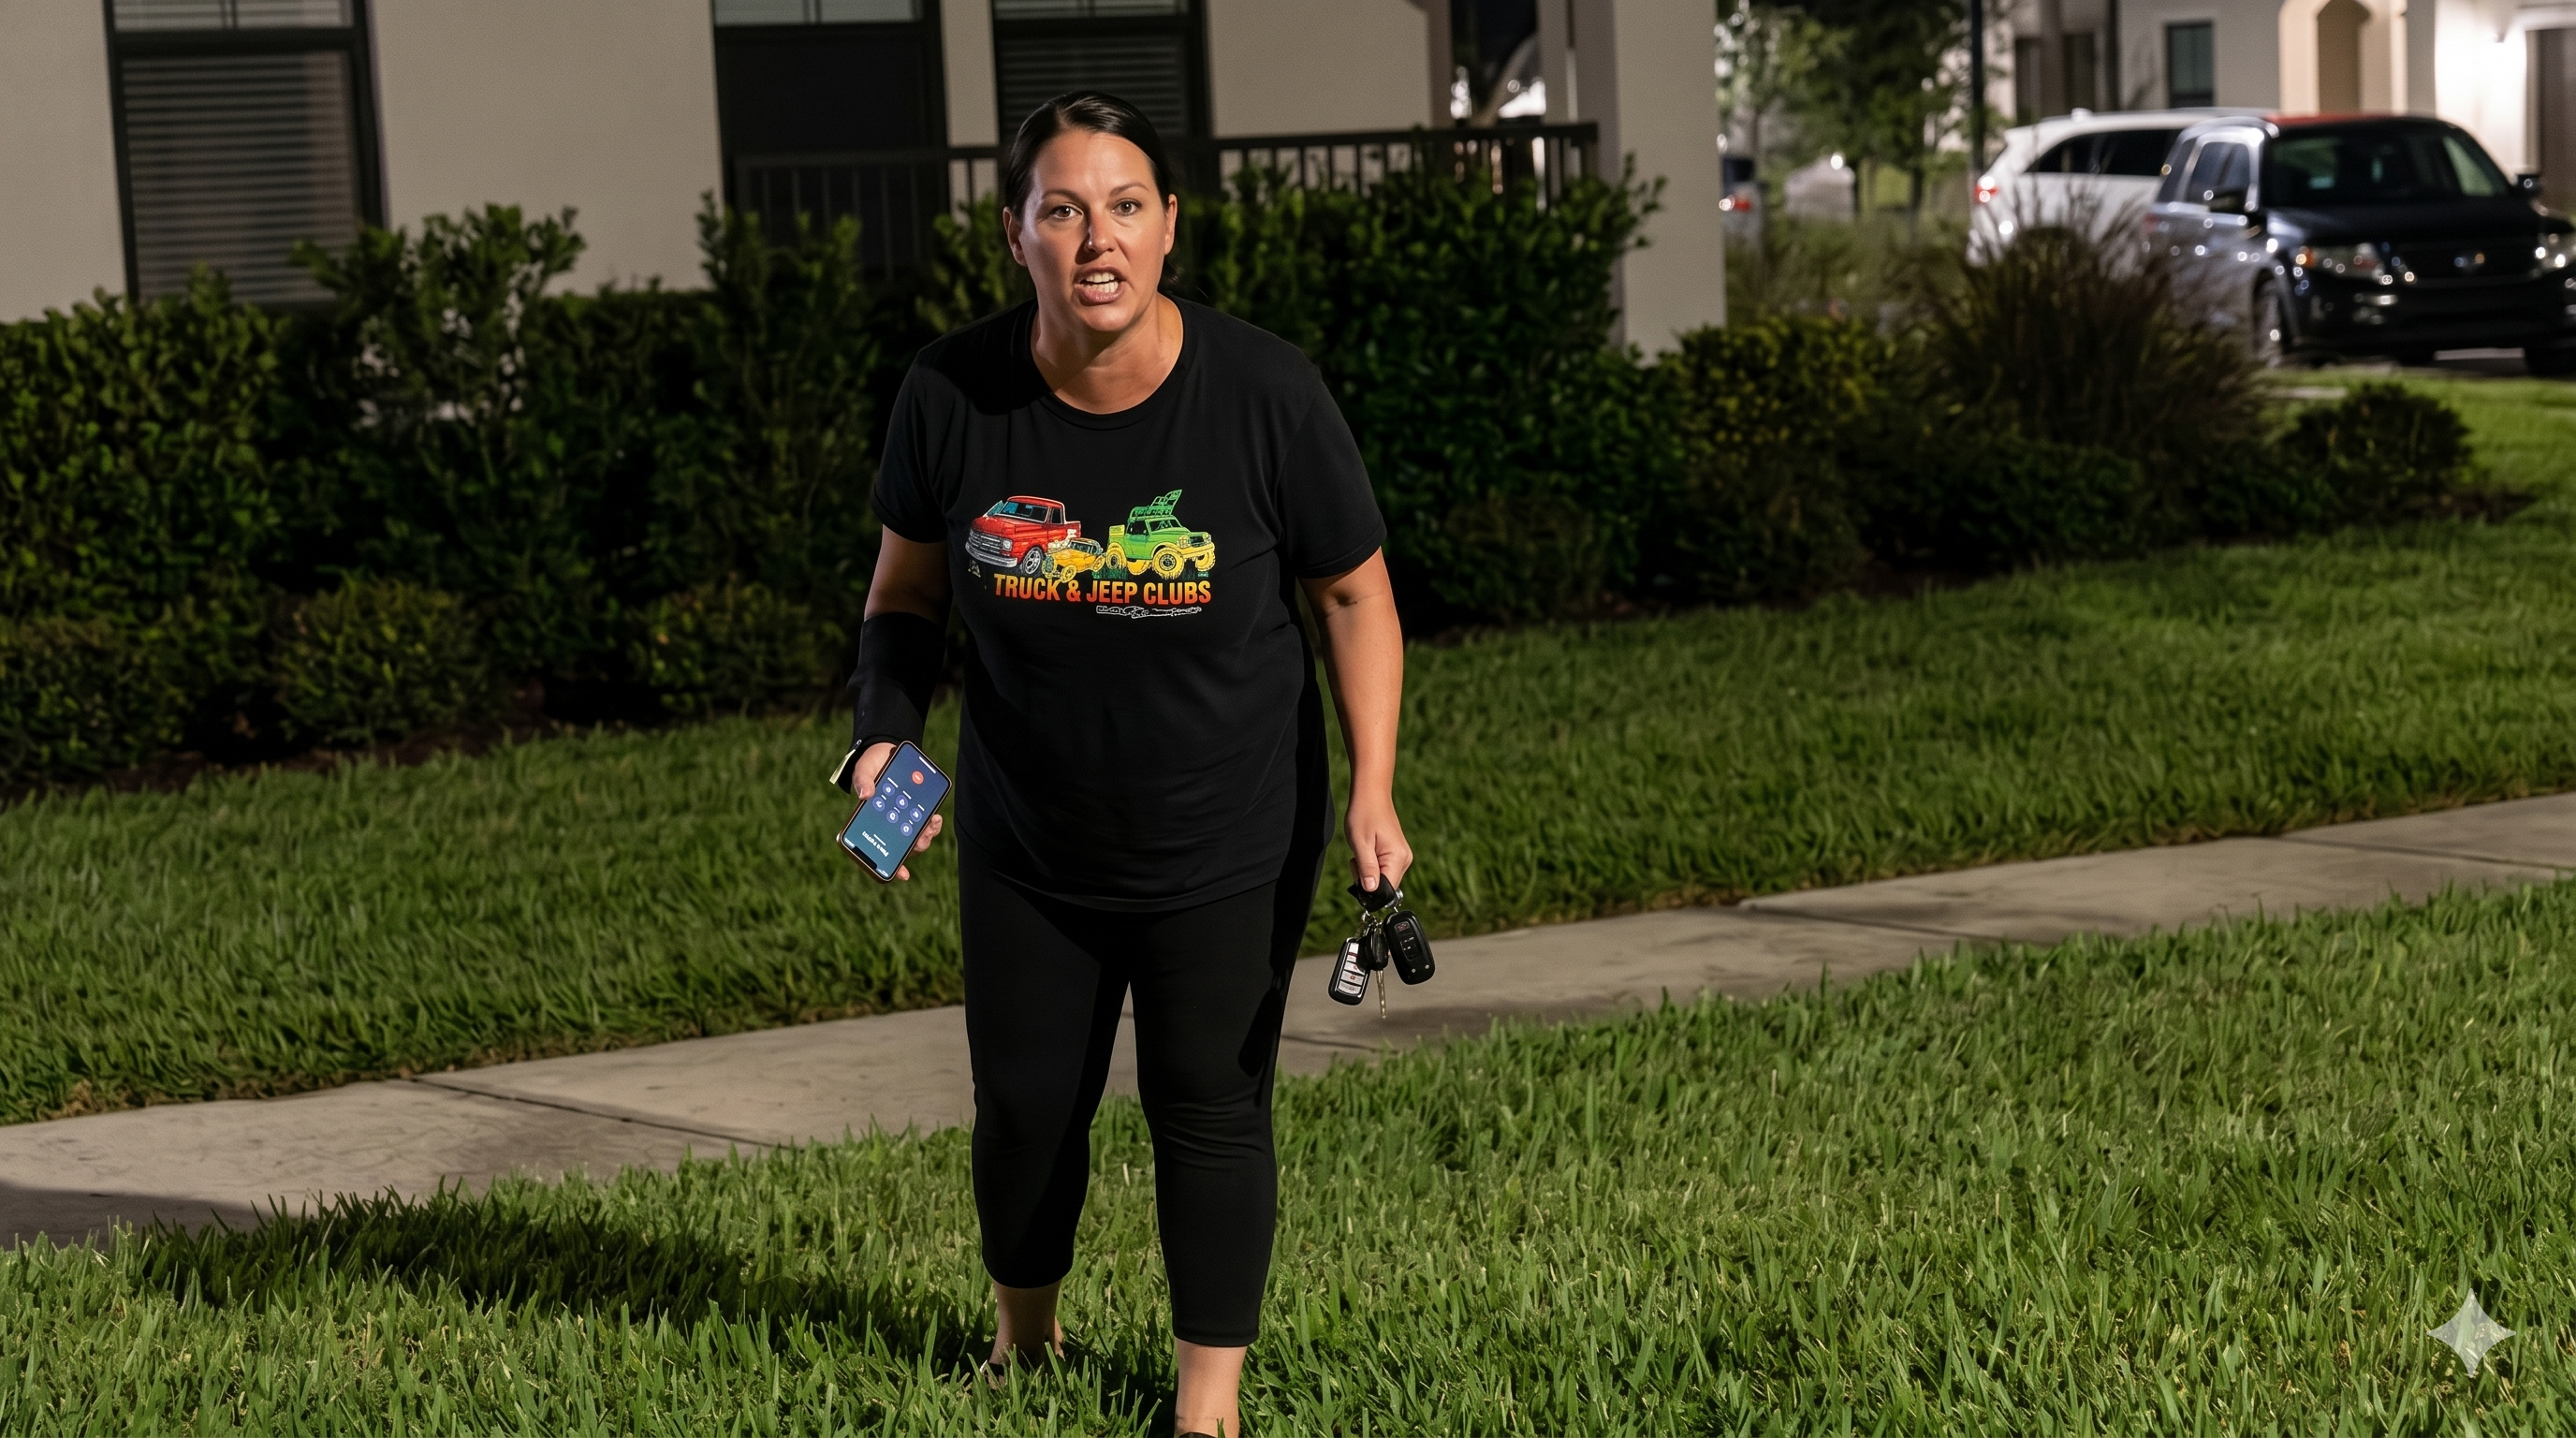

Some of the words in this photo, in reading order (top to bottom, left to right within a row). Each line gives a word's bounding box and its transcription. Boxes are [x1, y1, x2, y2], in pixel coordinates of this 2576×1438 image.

[994, 573, 1061, 601] TRUCK
[1068, 580, 1081, 602] &
[1086, 580, 1137, 604] JEEP
[1143, 580, 1211, 605] CLUBS
